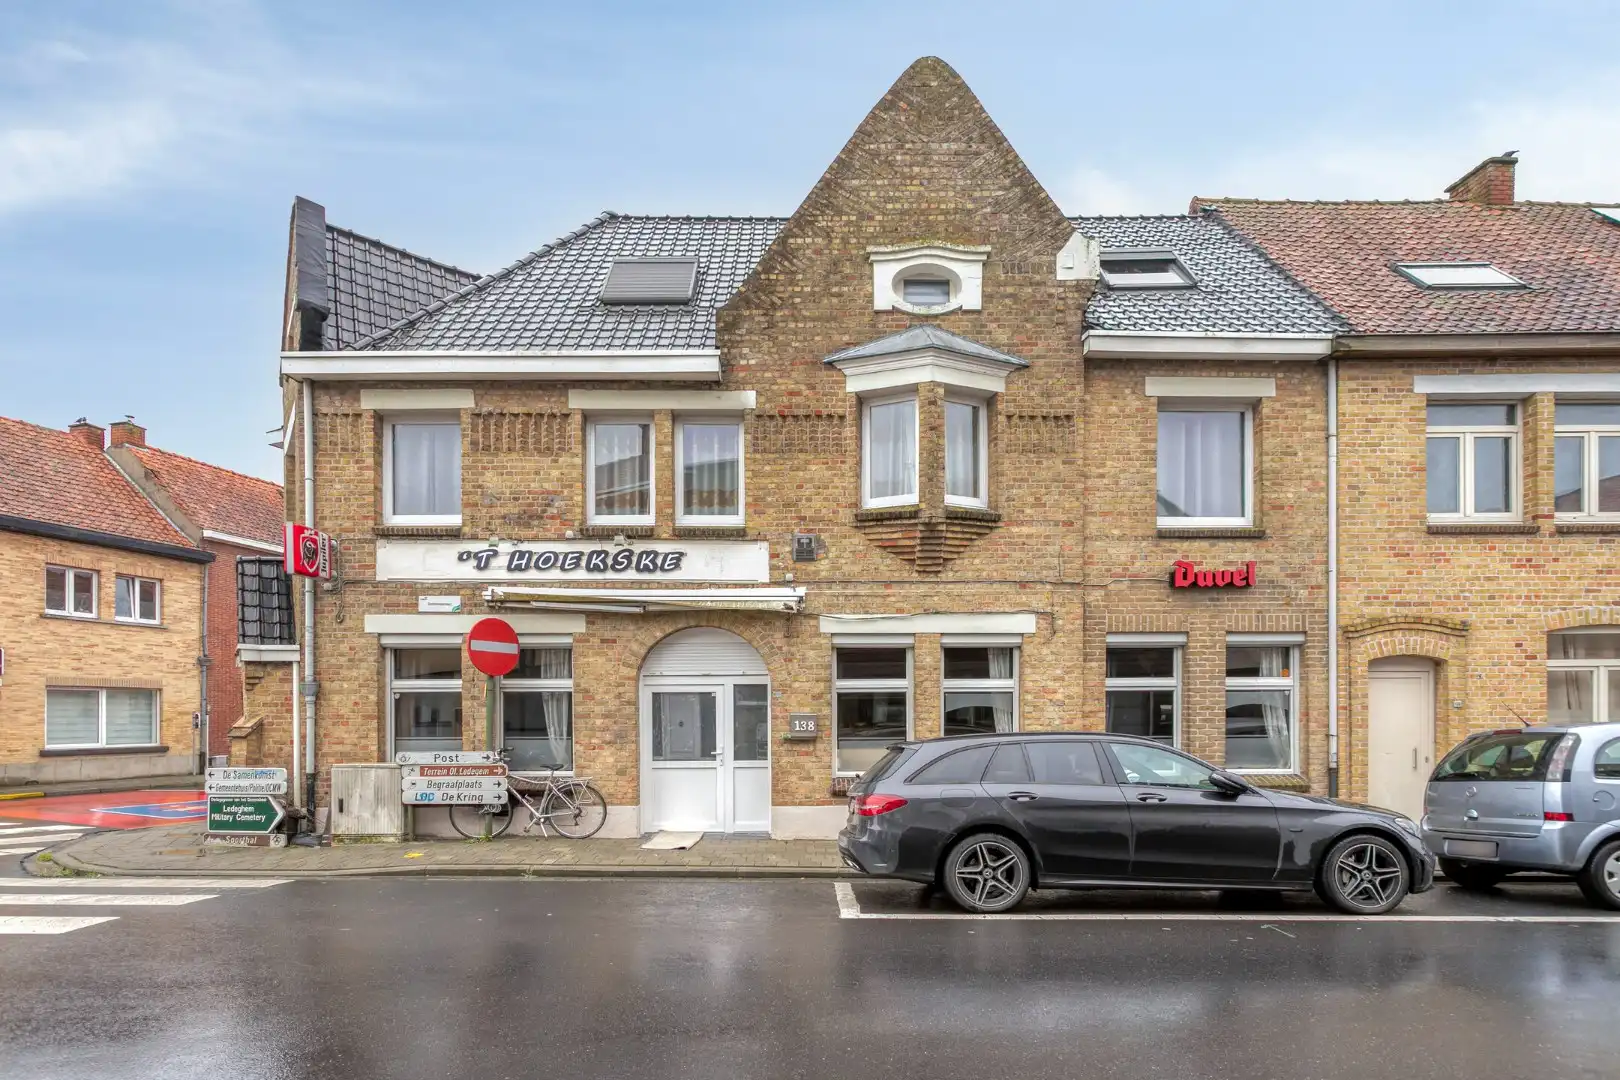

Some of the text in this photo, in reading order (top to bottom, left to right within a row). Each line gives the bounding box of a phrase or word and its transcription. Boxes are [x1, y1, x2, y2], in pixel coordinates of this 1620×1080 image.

[506, 549, 688, 573] HOEKSKE
[1171, 560, 1258, 588] Duvel
[794, 720, 815, 731] 138
[434, 753, 460, 762] Post
[222, 770, 275, 780] De Samenkomst
[424, 767, 448, 776] Terrein
[459, 767, 490, 777] Ledegem
[427, 780, 483, 791] Begraafplaats
[441, 792, 455, 801] De
[456, 792, 484, 804] Kring
[222, 805, 255, 813] Ledeghem
[211, 813, 266, 822] Military Cemetery
